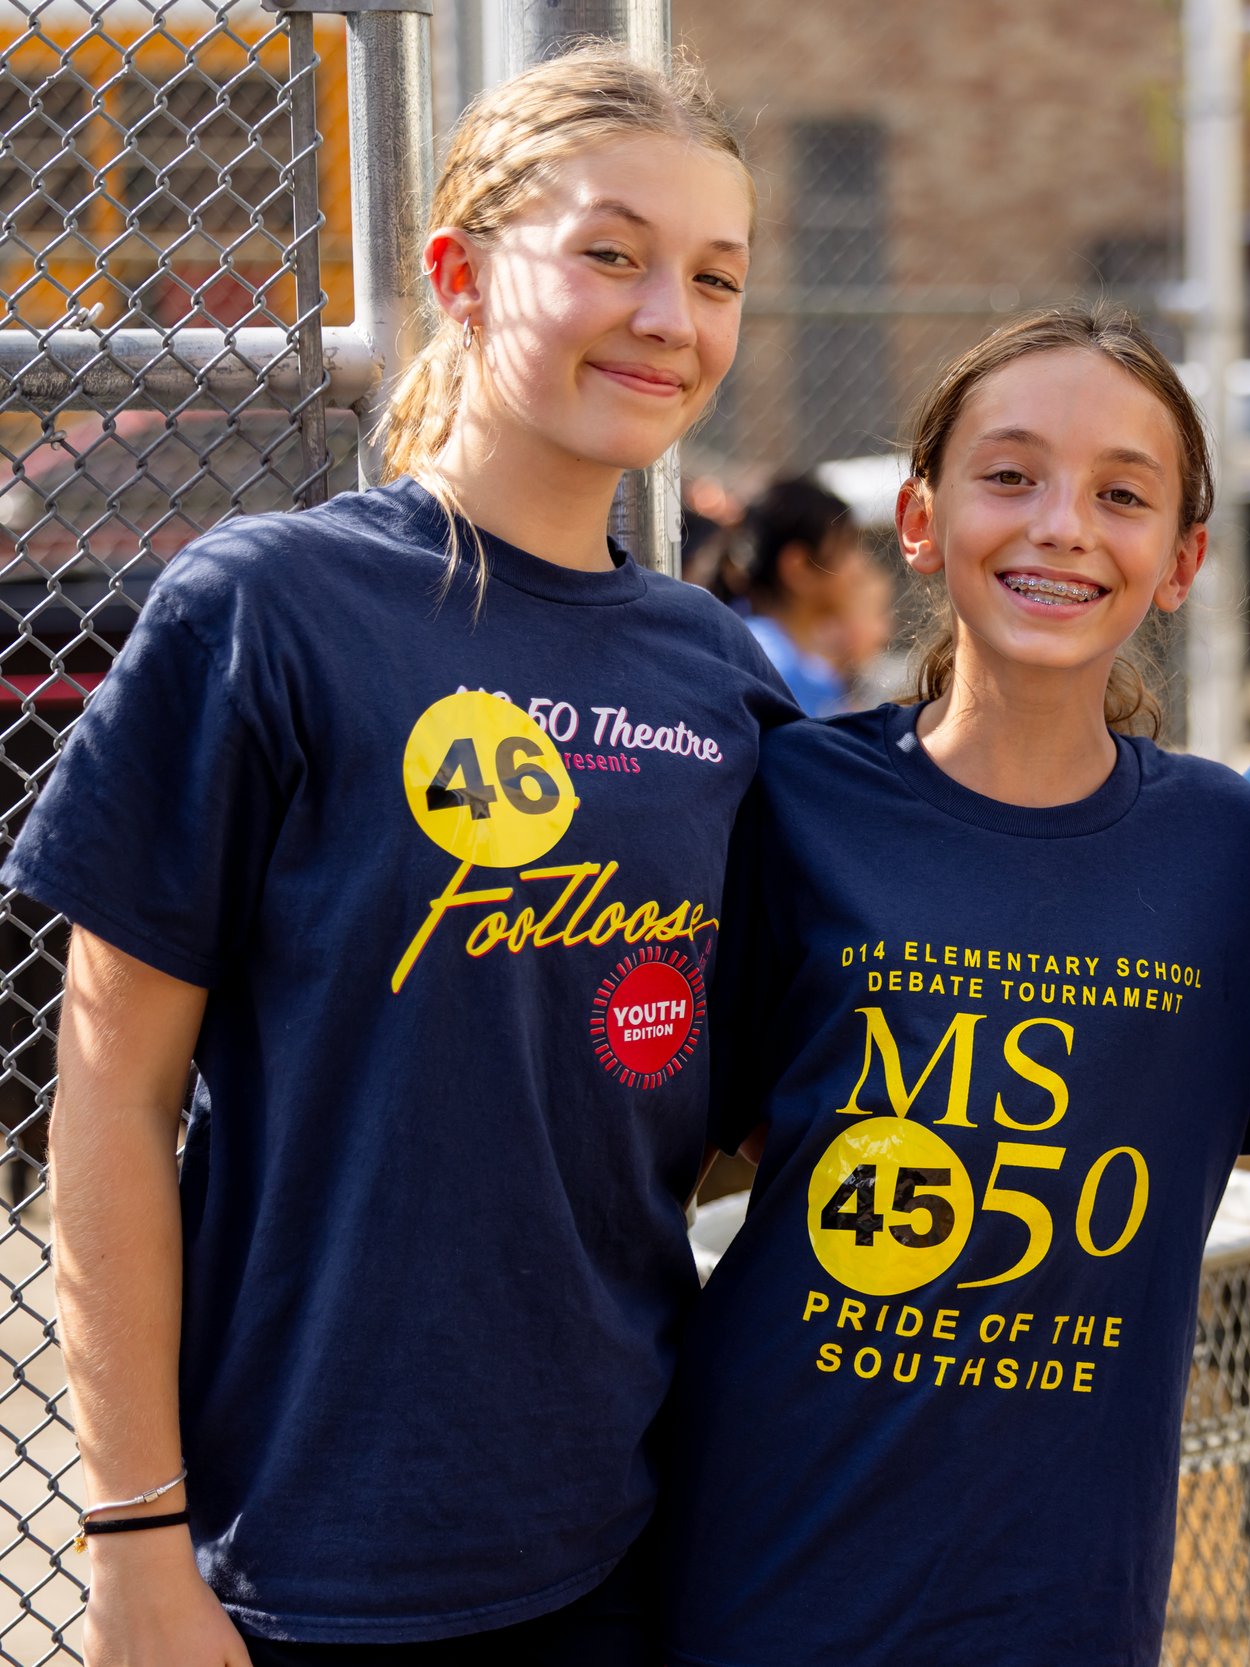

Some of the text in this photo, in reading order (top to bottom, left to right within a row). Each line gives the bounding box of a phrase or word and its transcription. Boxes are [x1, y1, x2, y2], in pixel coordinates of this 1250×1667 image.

[528, 697, 724, 764] 50 Theatre
[425, 736, 561, 821] 46
[559, 752, 641, 774] resents
[391, 860, 720, 994] Footloose
[841, 940, 1203, 989] D14 ELEMENTARY SCHOOL
[867, 971, 1184, 1015] DEBATE TOURNAMENT
[613, 999, 687, 1028] YOUTH
[624, 1023, 674, 1042] EDITION
[835, 1006, 1075, 1132] MS
[820, 1163, 956, 1250] 45
[956, 1141, 1150, 1290] 50
[802, 1290, 1123, 1349] PRIDE OF THE
[816, 1342, 1097, 1394] SOUTHSIDE
